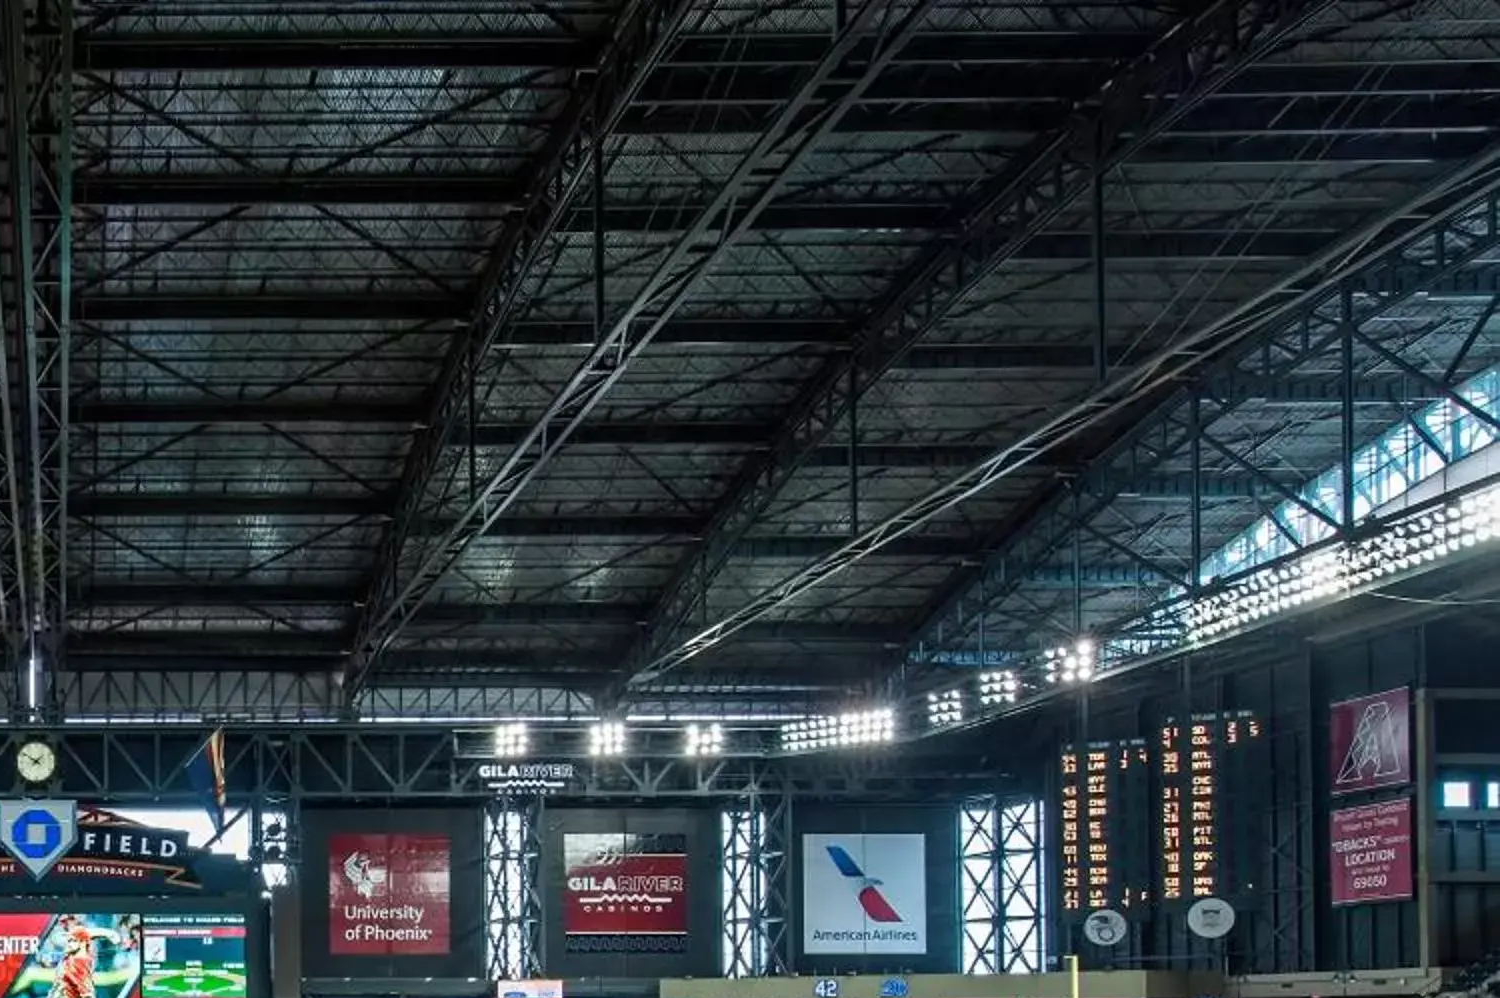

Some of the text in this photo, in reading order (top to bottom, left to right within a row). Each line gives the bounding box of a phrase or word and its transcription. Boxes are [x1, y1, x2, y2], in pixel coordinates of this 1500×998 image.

[83, 832, 178, 858] FIELD
[1345, 848, 1396, 867] LOCATION
[57, 865, 145, 878] DIAMONDBACKS
[344, 905, 425, 923] University
[345, 924, 363, 940] of
[813, 929, 919, 940] American Airlines
[815, 980, 837, 997] 42
